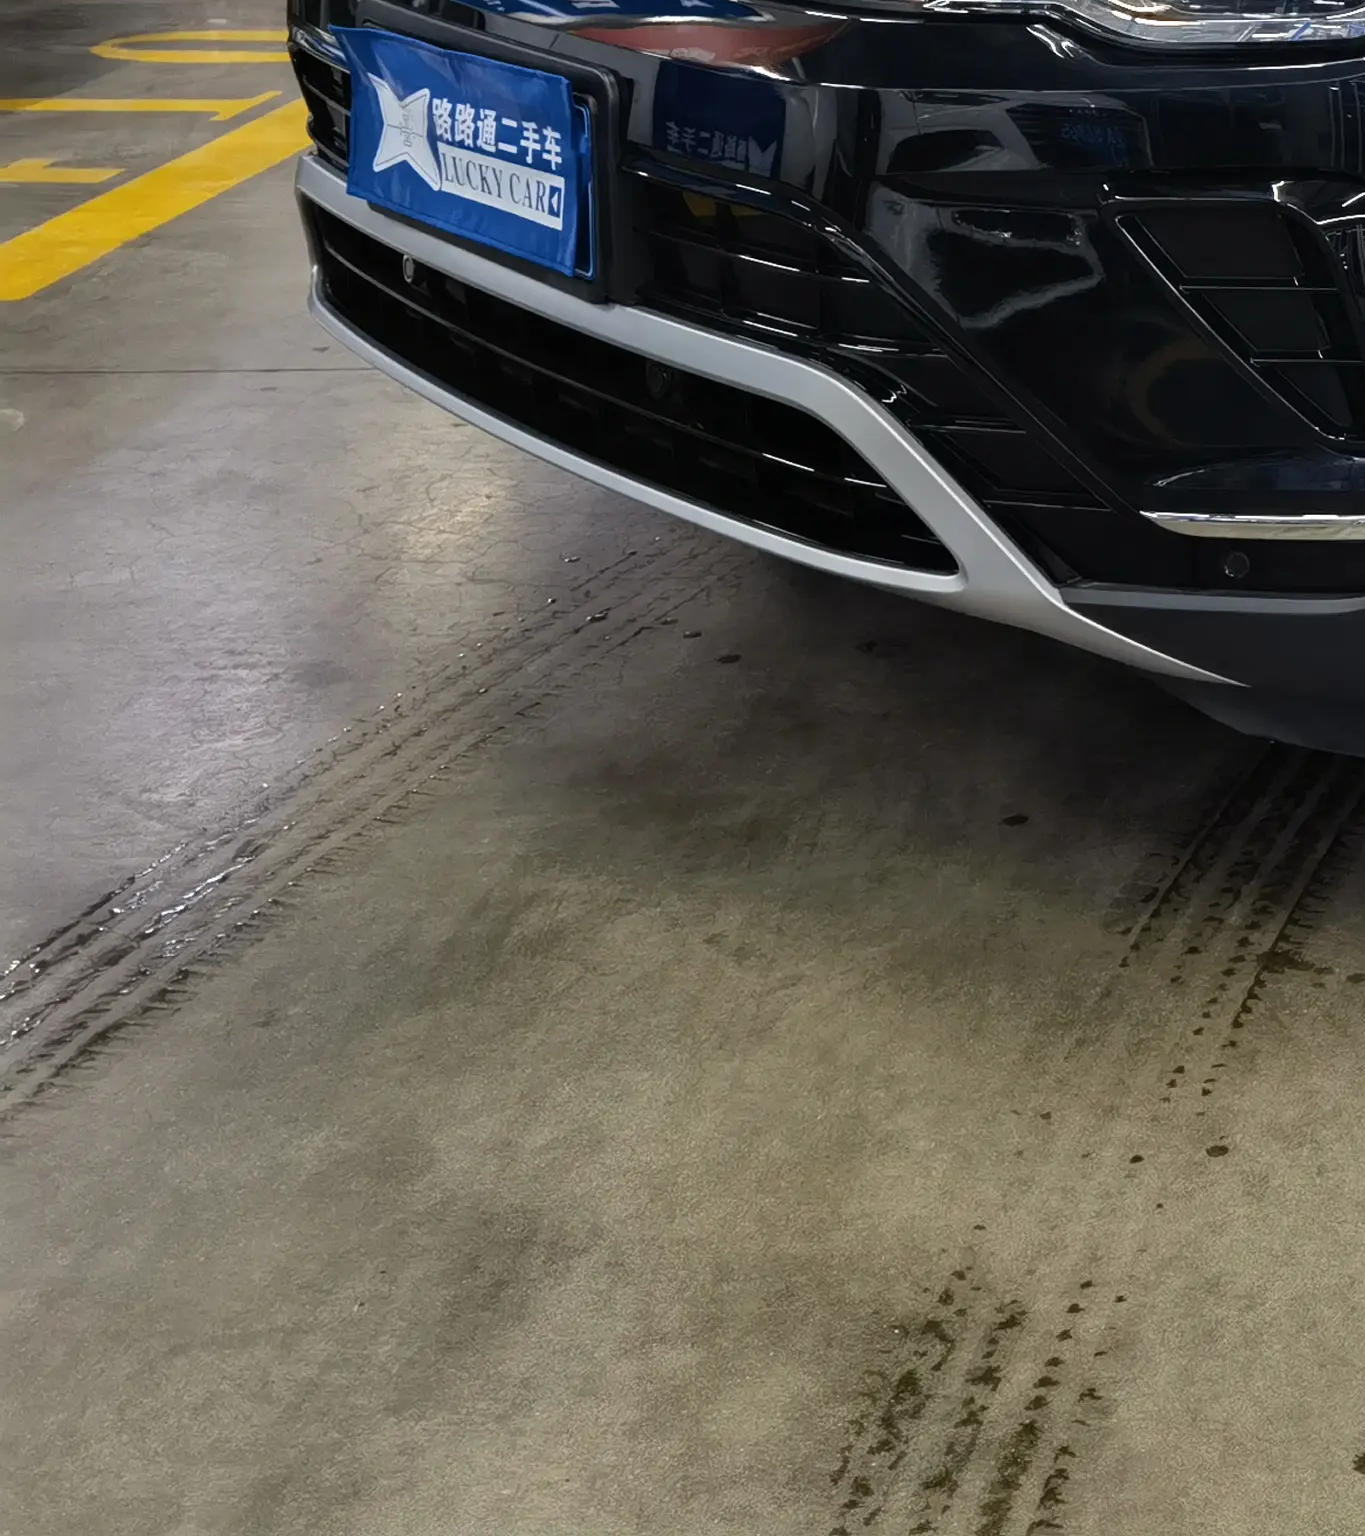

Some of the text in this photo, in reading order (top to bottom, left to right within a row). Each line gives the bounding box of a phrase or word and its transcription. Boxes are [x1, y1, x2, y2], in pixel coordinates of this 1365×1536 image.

[432, 98, 563, 171] 路路通二手车
[441, 152, 549, 214] LUCKY CAR
